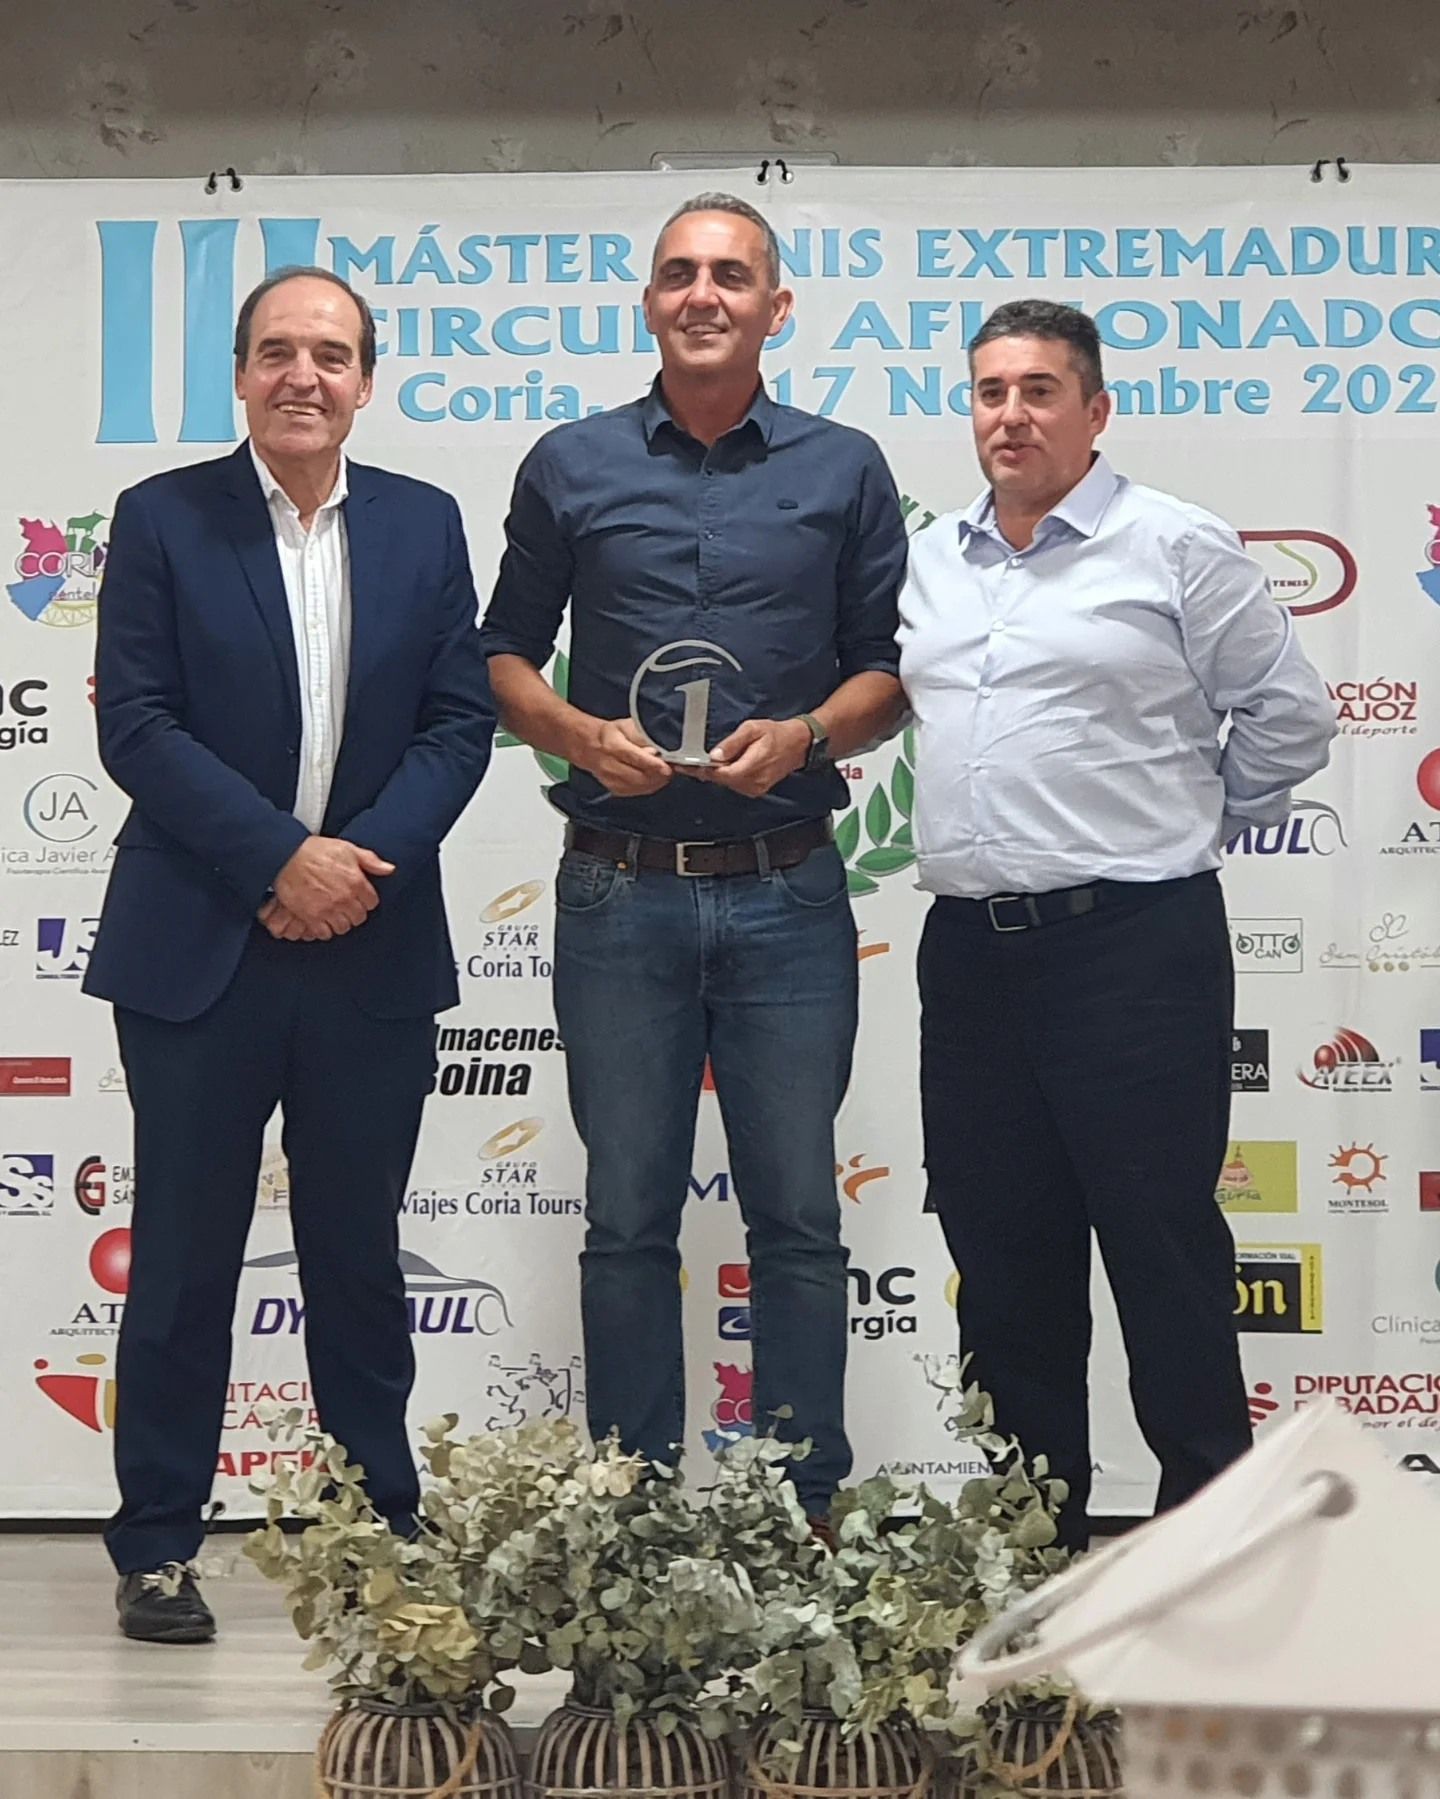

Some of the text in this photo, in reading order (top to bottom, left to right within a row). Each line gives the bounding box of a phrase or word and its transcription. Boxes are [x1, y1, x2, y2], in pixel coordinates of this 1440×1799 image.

[327, 224, 1440, 284] MÁSTER NIS EXTREMADUR
[1351, 724, 1417, 739] deporte
[36, 846, 97, 864] Javier
[483, 932, 539, 947] STAR
[467, 954, 523, 978] Coria
[481, 1168, 537, 1183] STAR
[401, 1190, 582, 1222] Viajes Coria Tours
[851, 1309, 917, 1340] rgía
[1295, 1373, 1440, 1395] DIPUTACI
[1397, 1416, 1414, 1428] el
